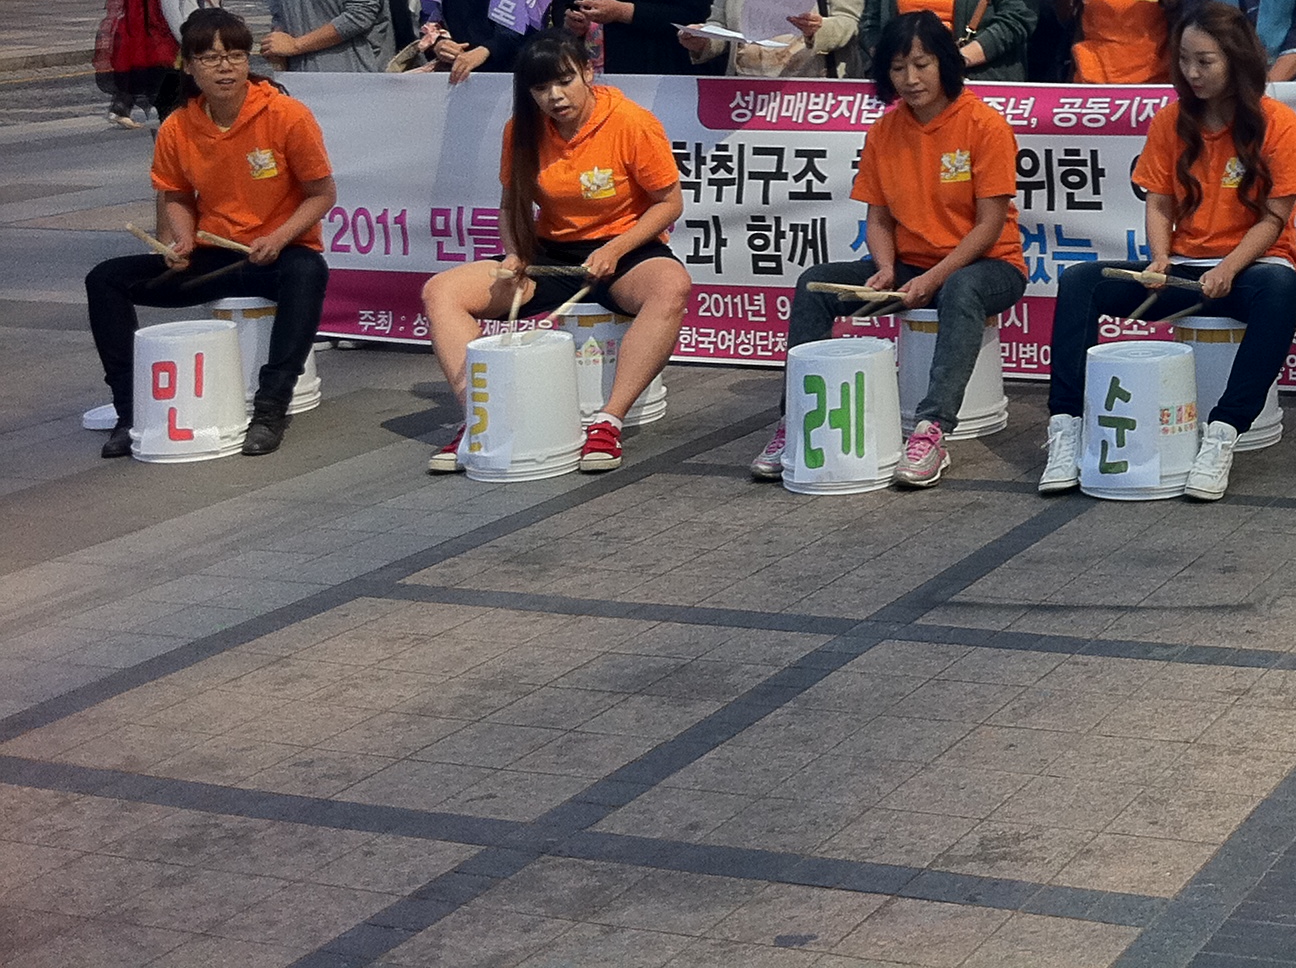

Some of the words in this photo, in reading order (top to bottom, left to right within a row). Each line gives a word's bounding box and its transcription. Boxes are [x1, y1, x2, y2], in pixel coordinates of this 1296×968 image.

[728, 90, 885, 125] 성매매방지법
[671, 141, 833, 205] 착취구조
[1015, 147, 1106, 212] 위한
[328, 206, 409, 256] 2011
[430, 205, 505, 262] 민들
[746, 215, 830, 276] 함께
[358, 310, 393, 334] 주최
[697, 292, 767, 322] 2011년
[152, 352, 204, 441] 민
[803, 371, 866, 470] 레
[1098, 376, 1138, 475] 순
